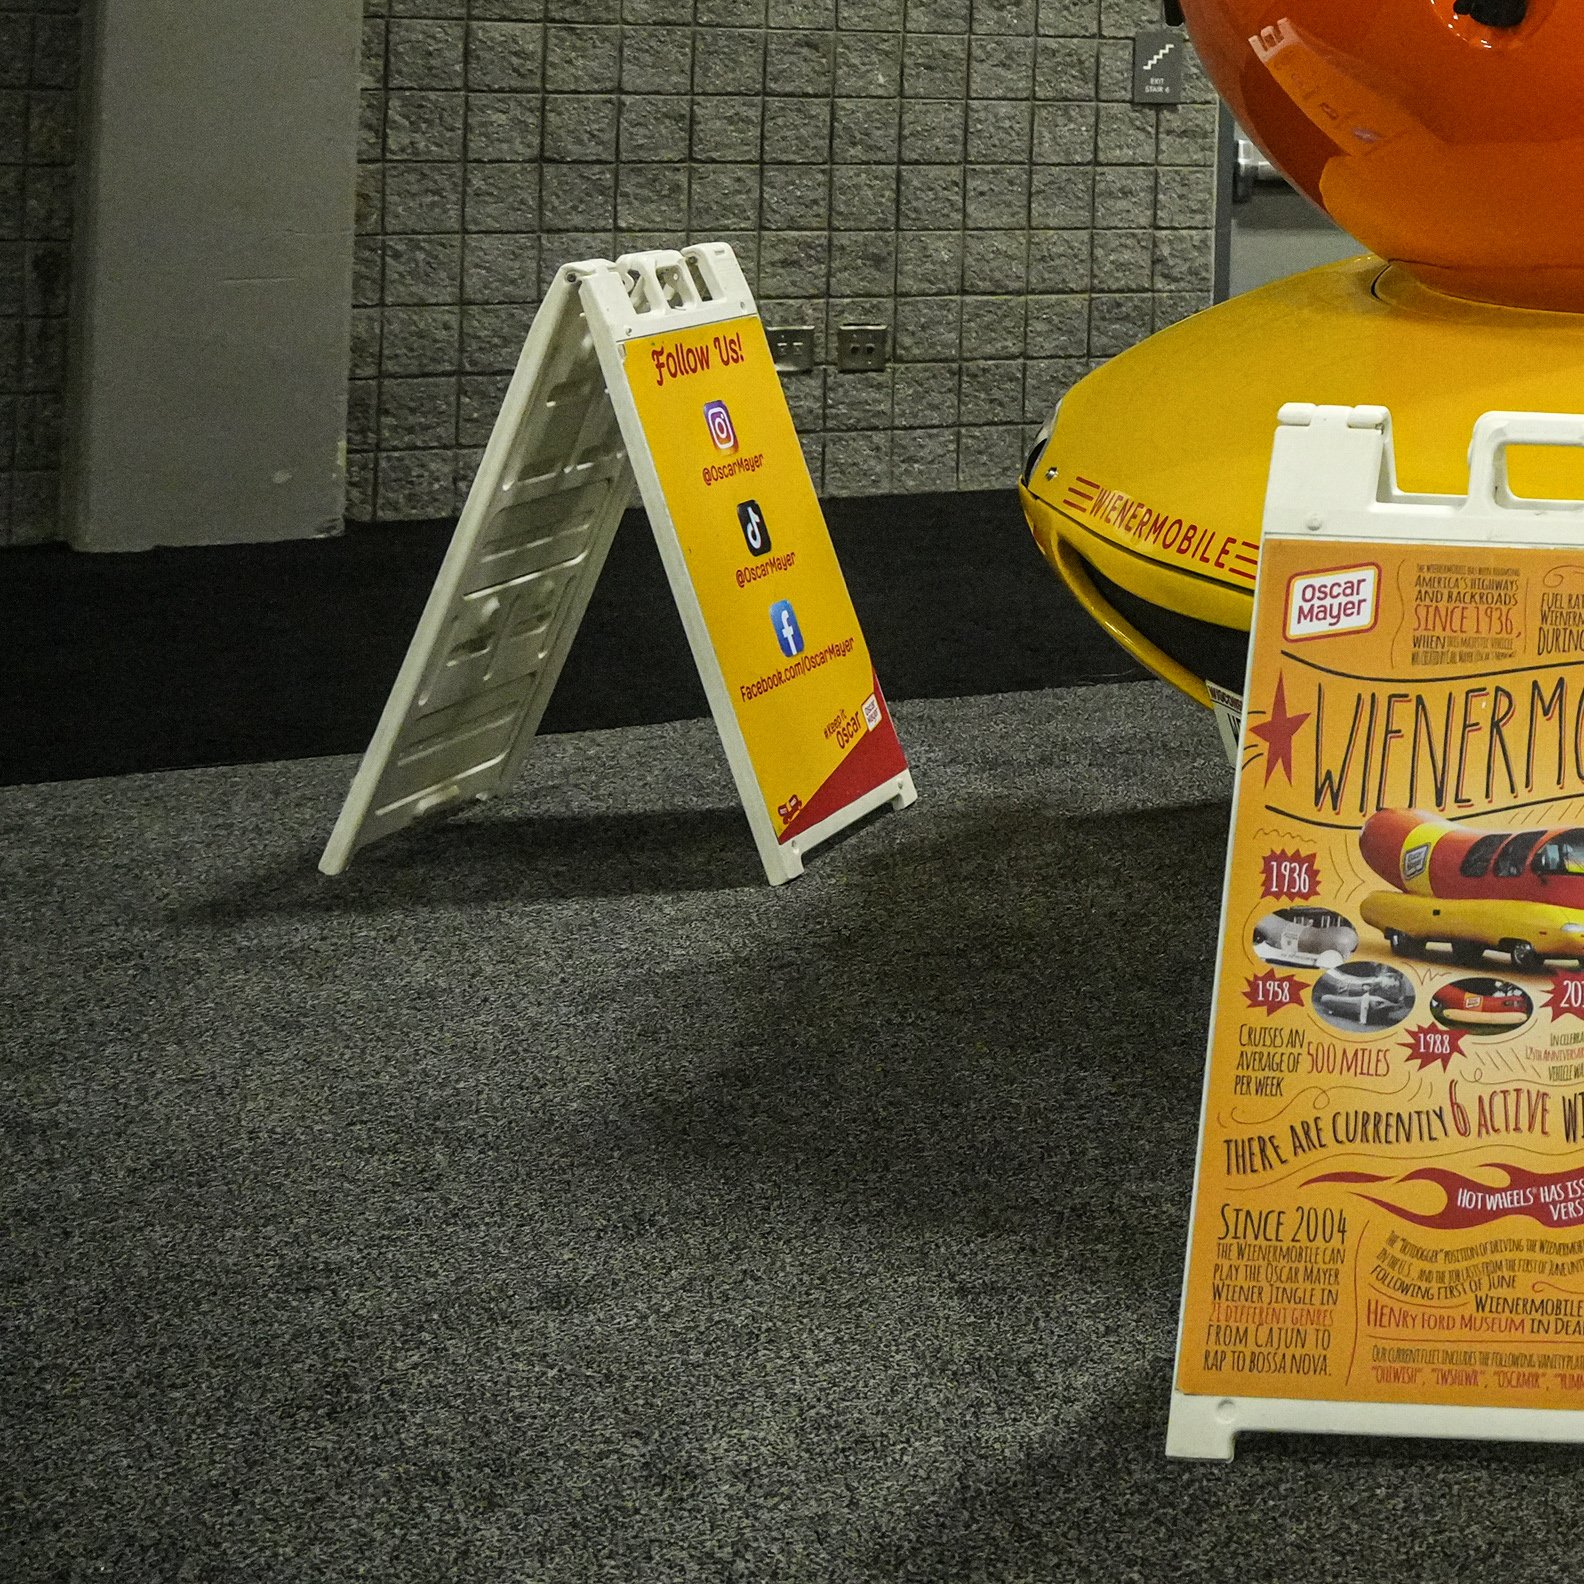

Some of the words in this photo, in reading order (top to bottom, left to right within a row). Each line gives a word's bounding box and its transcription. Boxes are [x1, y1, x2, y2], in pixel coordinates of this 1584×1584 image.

[652, 343, 710, 386] Follow
[714, 332, 744, 366] Us!
[703, 453, 764, 486] @OscarMayer
[1090, 488, 1236, 569] WIENERMOBILE
[736, 551, 796, 588] @OscarMayer
[1415, 575, 1468, 590] AMERICA'S
[1471, 578, 1518, 592] HIGHWAYS
[1302, 578, 1366, 603] Oscar
[1415, 589, 1443, 603] AND
[1447, 591, 1518, 606] BACKROADS
[1541, 592, 1563, 611] FUEL
[1297, 597, 1366, 626] Mayer
[1413, 604, 1468, 633] SINCE
[1474, 606, 1521, 638] 1936,
[1413, 635, 1445, 649] WHEN
[740, 637, 854, 702] Facebook.com/OscarMayer
[836, 712, 860, 749] Oscar
[1270, 861, 1310, 893] 1936
[1256, 980, 1290, 1002] 1958
[1239, 1023, 1284, 1048] CRUISES
[1285, 1027, 1306, 1049] AN
[1418, 1033, 1450, 1054] 1988
[1236, 1051, 1286, 1072] AVERAGE
[1287, 1052, 1303, 1073] OF
[1307, 1041, 1337, 1074] 500
[1340, 1048, 1390, 1078] MILES
[1234, 1075, 1254, 1096] PER
[1255, 1076, 1284, 1097] WEEK
[1223, 1133, 1290, 1176] THERE
[1291, 1115, 1327, 1157] ARE
[1332, 1105, 1450, 1146] CURRENTLY
[1450, 1079, 1468, 1138] 6
[1476, 1087, 1550, 1138] ACTIVE
[1457, 1187, 1483, 1210] HOT
[1540, 1179, 1566, 1203] HAS
[1218, 1204, 1285, 1242] SINCE
[1292, 1206, 1347, 1245] 2004
[1216, 1242, 1234, 1260] THE
[1236, 1242, 1320, 1265] WIENERMOBILE
[1322, 1246, 1346, 1265] CAN
[1213, 1264, 1240, 1282] PLAY
[1243, 1264, 1261, 1283] THE
[1265, 1264, 1300, 1284] OSCAR
[1303, 1266, 1340, 1285] MAYER
[1370, 1264, 1434, 1301] FOLLOWING
[1437, 1283, 1467, 1300] FIRST
[1469, 1278, 1482, 1293] OF
[1488, 1274, 1517, 1291] JUNE
[1211, 1282, 1264, 1304] WIENER
[1268, 1283, 1316, 1306] JINGLE
[1320, 1288, 1339, 1306] IN
[1474, 1293, 1584, 1318] WIENERMOBILE
[1366, 1298, 1420, 1329] HENRY
[1421, 1312, 1455, 1331] FORD
[1460, 1314, 1526, 1335] MUSEUM
[1529, 1317, 1551, 1334] IN
[1205, 1324, 1249, 1347] FROM
[1254, 1324, 1308, 1350] CAJUN
[1314, 1328, 1331, 1351] TO
[1203, 1350, 1229, 1372] RAP
[1231, 1350, 1247, 1373] TO
[1249, 1350, 1288, 1374] BOSSA
[1291, 1352, 1332, 1377] NOVA.
